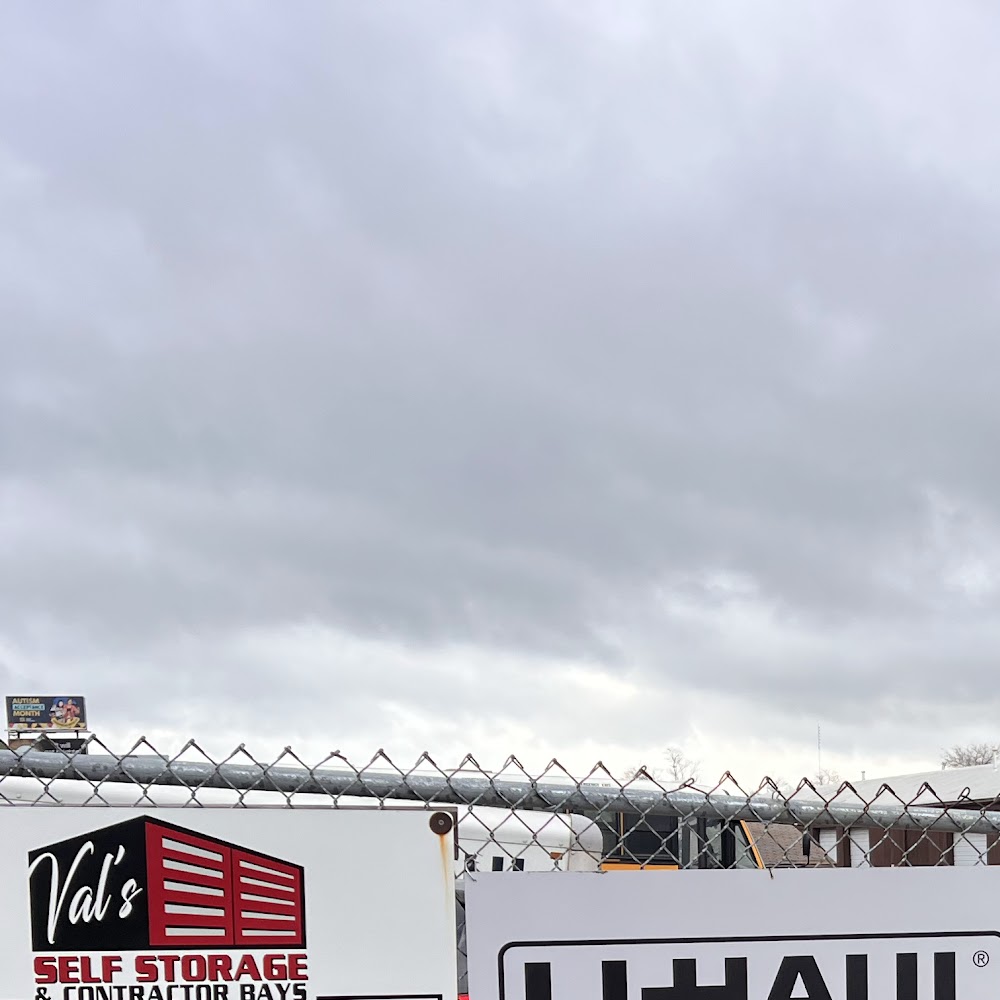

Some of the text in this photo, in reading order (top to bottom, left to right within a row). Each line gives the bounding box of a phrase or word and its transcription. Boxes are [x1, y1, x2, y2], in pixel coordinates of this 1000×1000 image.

[29, 840, 144, 945] Val's
[33, 953, 309, 985] SELF STORAGE
